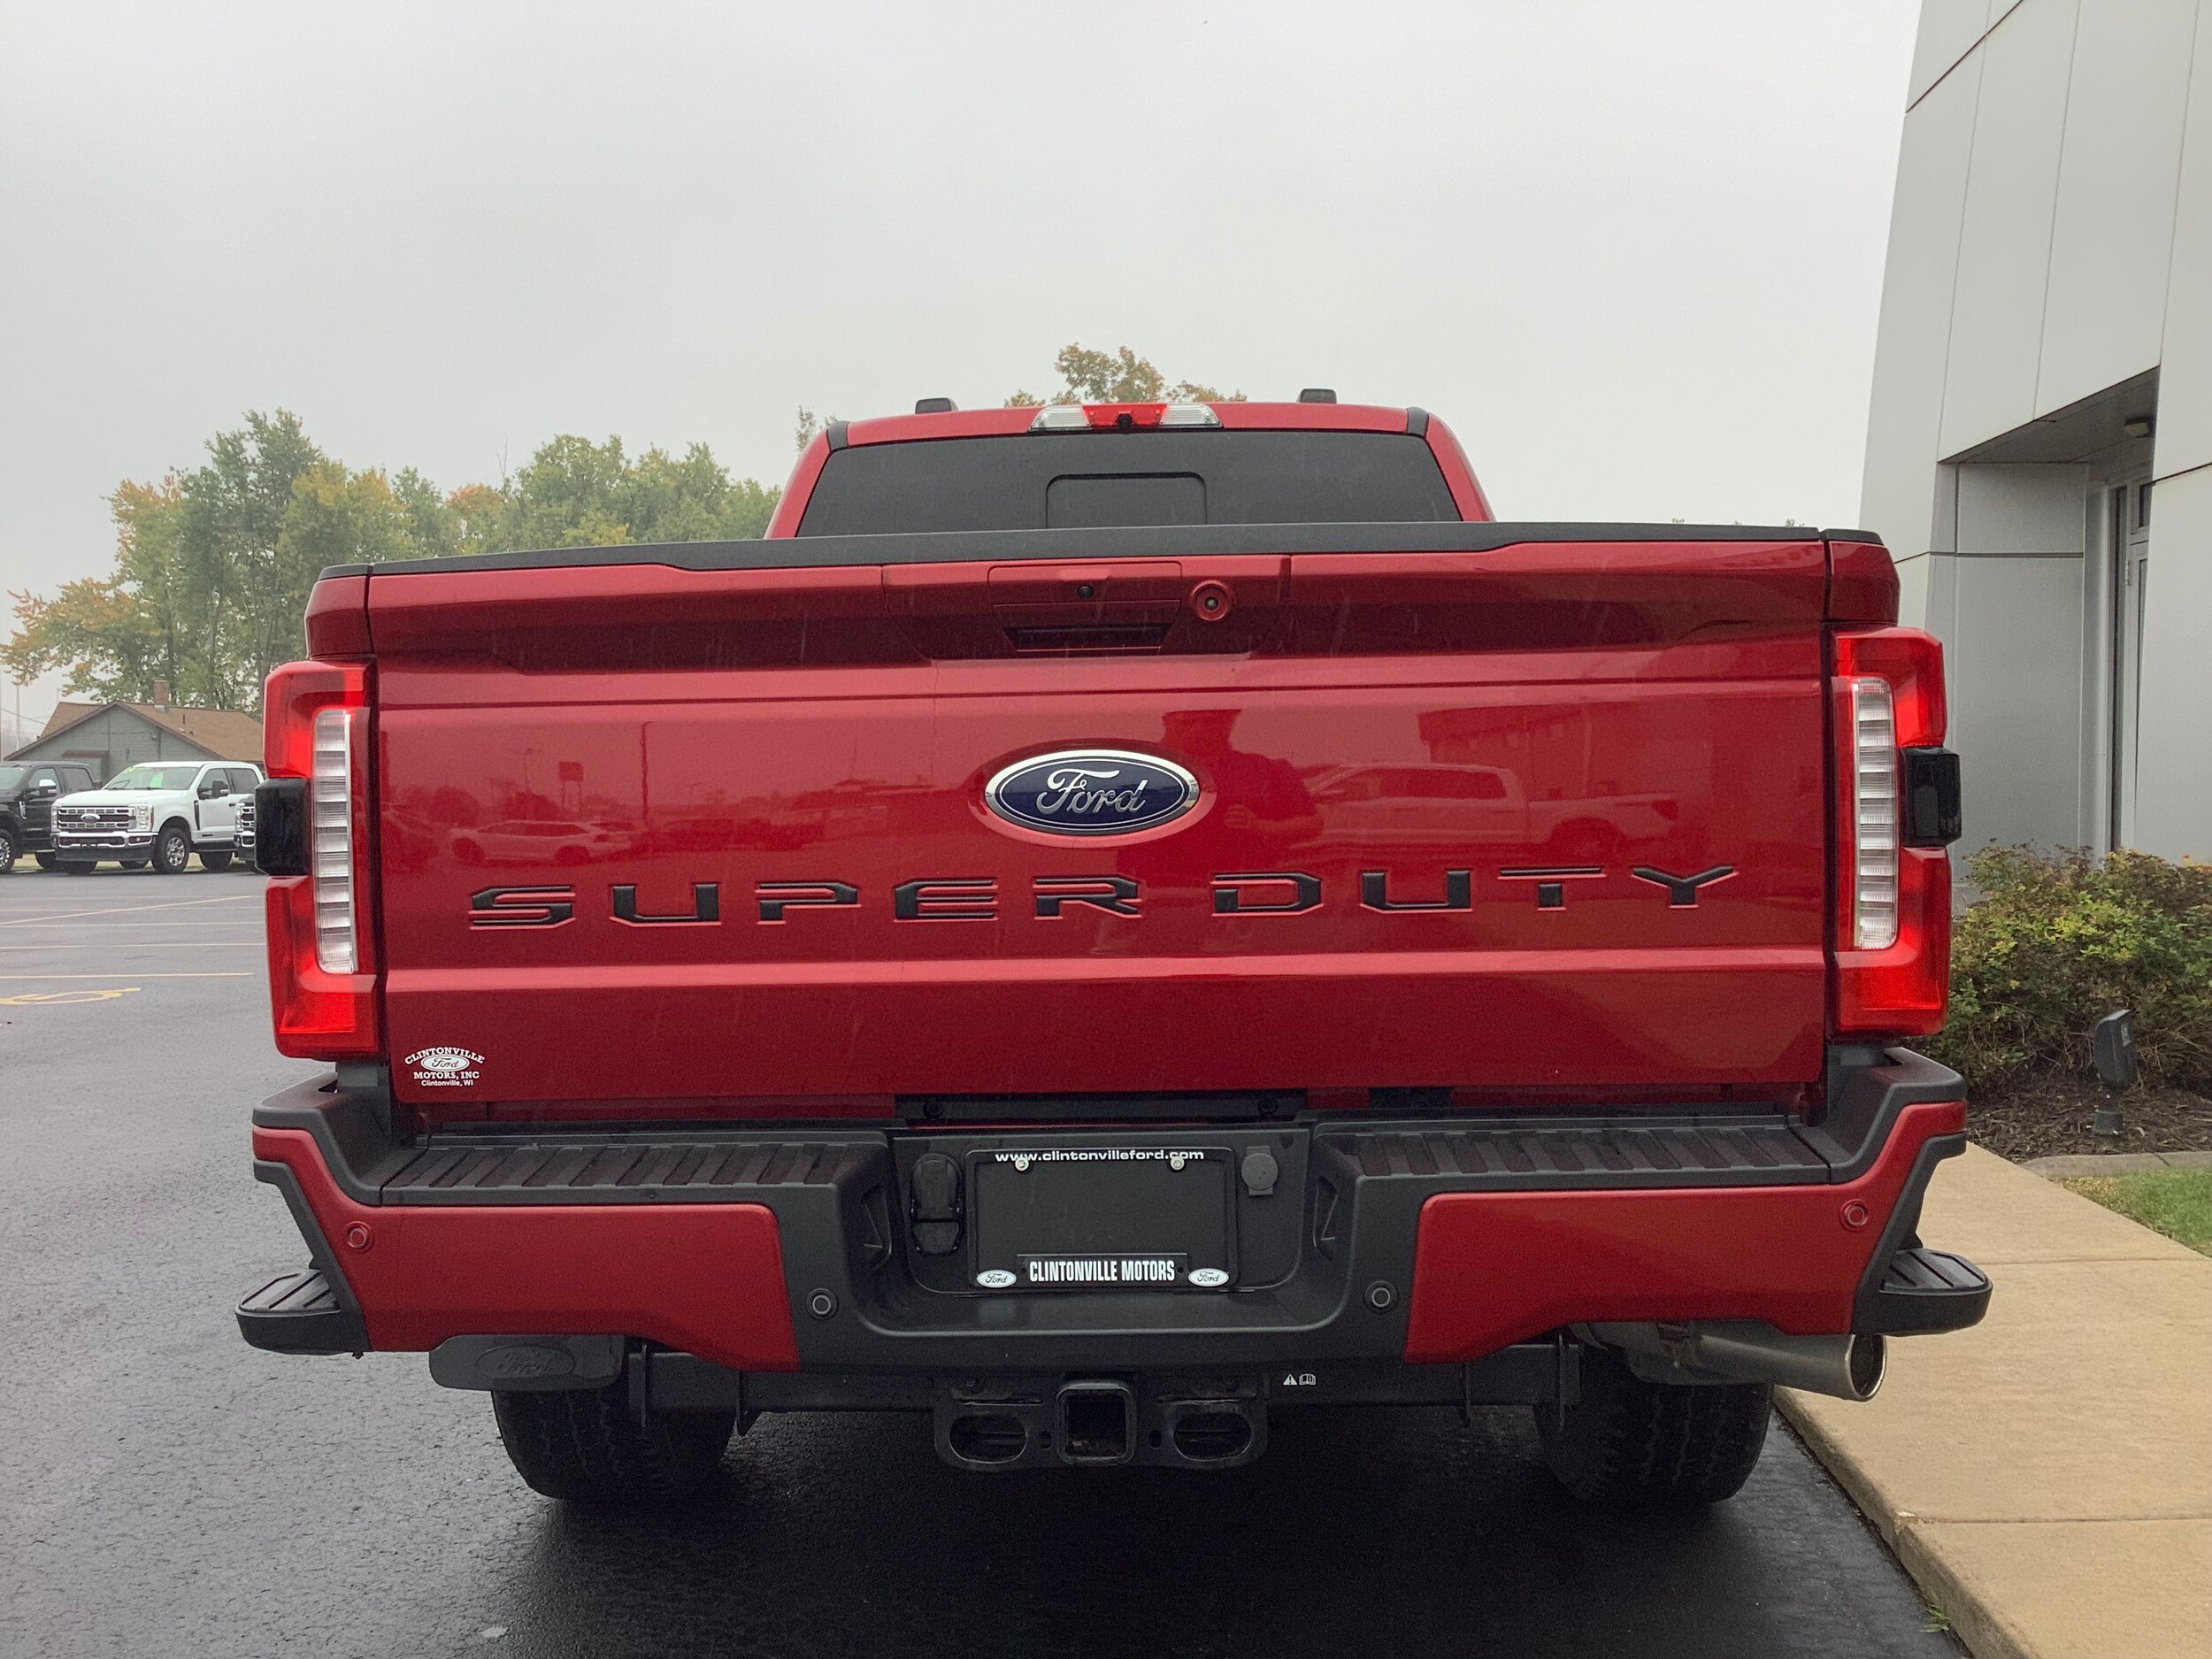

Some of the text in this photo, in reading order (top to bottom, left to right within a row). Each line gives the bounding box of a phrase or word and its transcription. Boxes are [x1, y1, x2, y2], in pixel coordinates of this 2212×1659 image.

[1036, 768, 1148, 814] Ford
[469, 865, 1739, 930] SUPER DUTY
[404, 1047, 486, 1064] CLINTONVILLE
[431, 1057, 459, 1068] Ford
[413, 1071, 459, 1080] MOTORS,
[995, 1150, 1204, 1162] www.clintonvilleford.com
[1029, 1260, 1175, 1282] CLINTONVILLE MOTORS
[1197, 1271, 1220, 1284] Ford
[984, 1273, 1008, 1286] Ford
